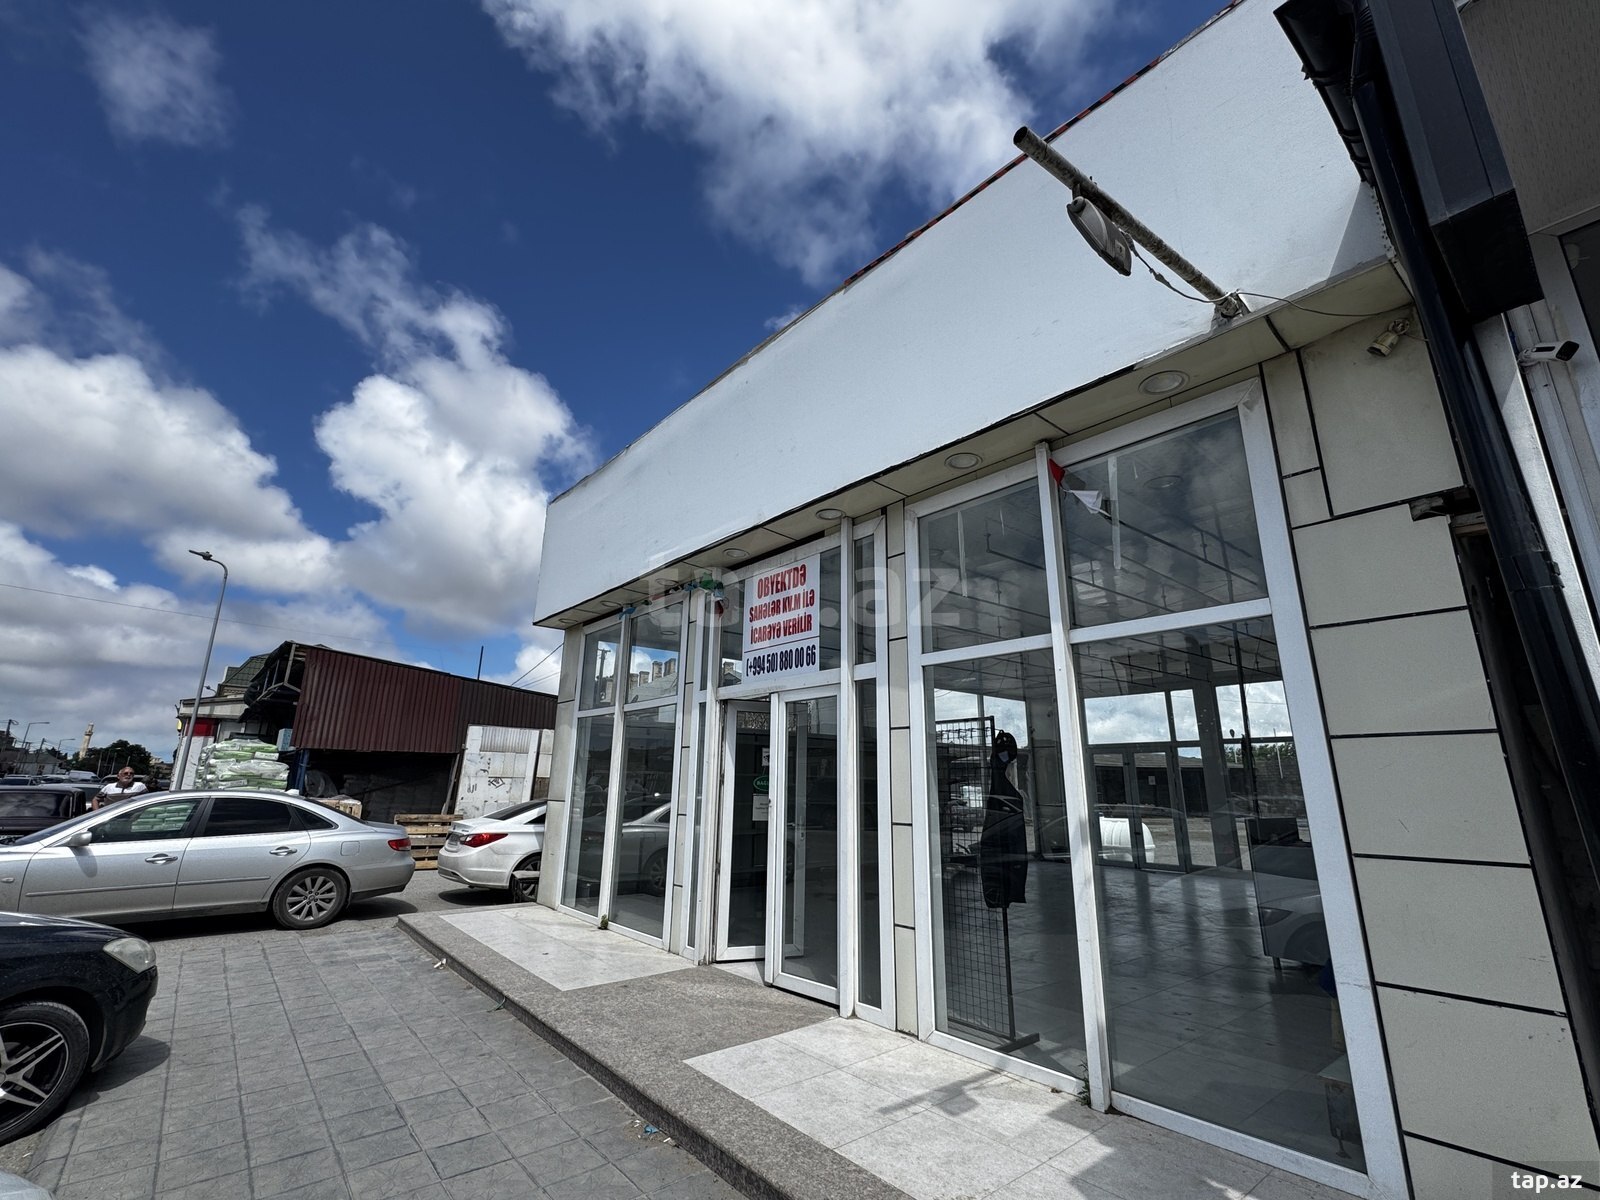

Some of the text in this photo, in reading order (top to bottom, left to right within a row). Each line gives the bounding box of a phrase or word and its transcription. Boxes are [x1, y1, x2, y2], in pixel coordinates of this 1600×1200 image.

[757, 564, 807, 600] OBYEKTDƏ
[749, 589, 815, 623] SAHƏLƏR KV.M İLƏ
[750, 612, 812, 645] İCARƏYƏ VERİLİR
[746, 644, 816, 677] (+994 50) 880 00 66
